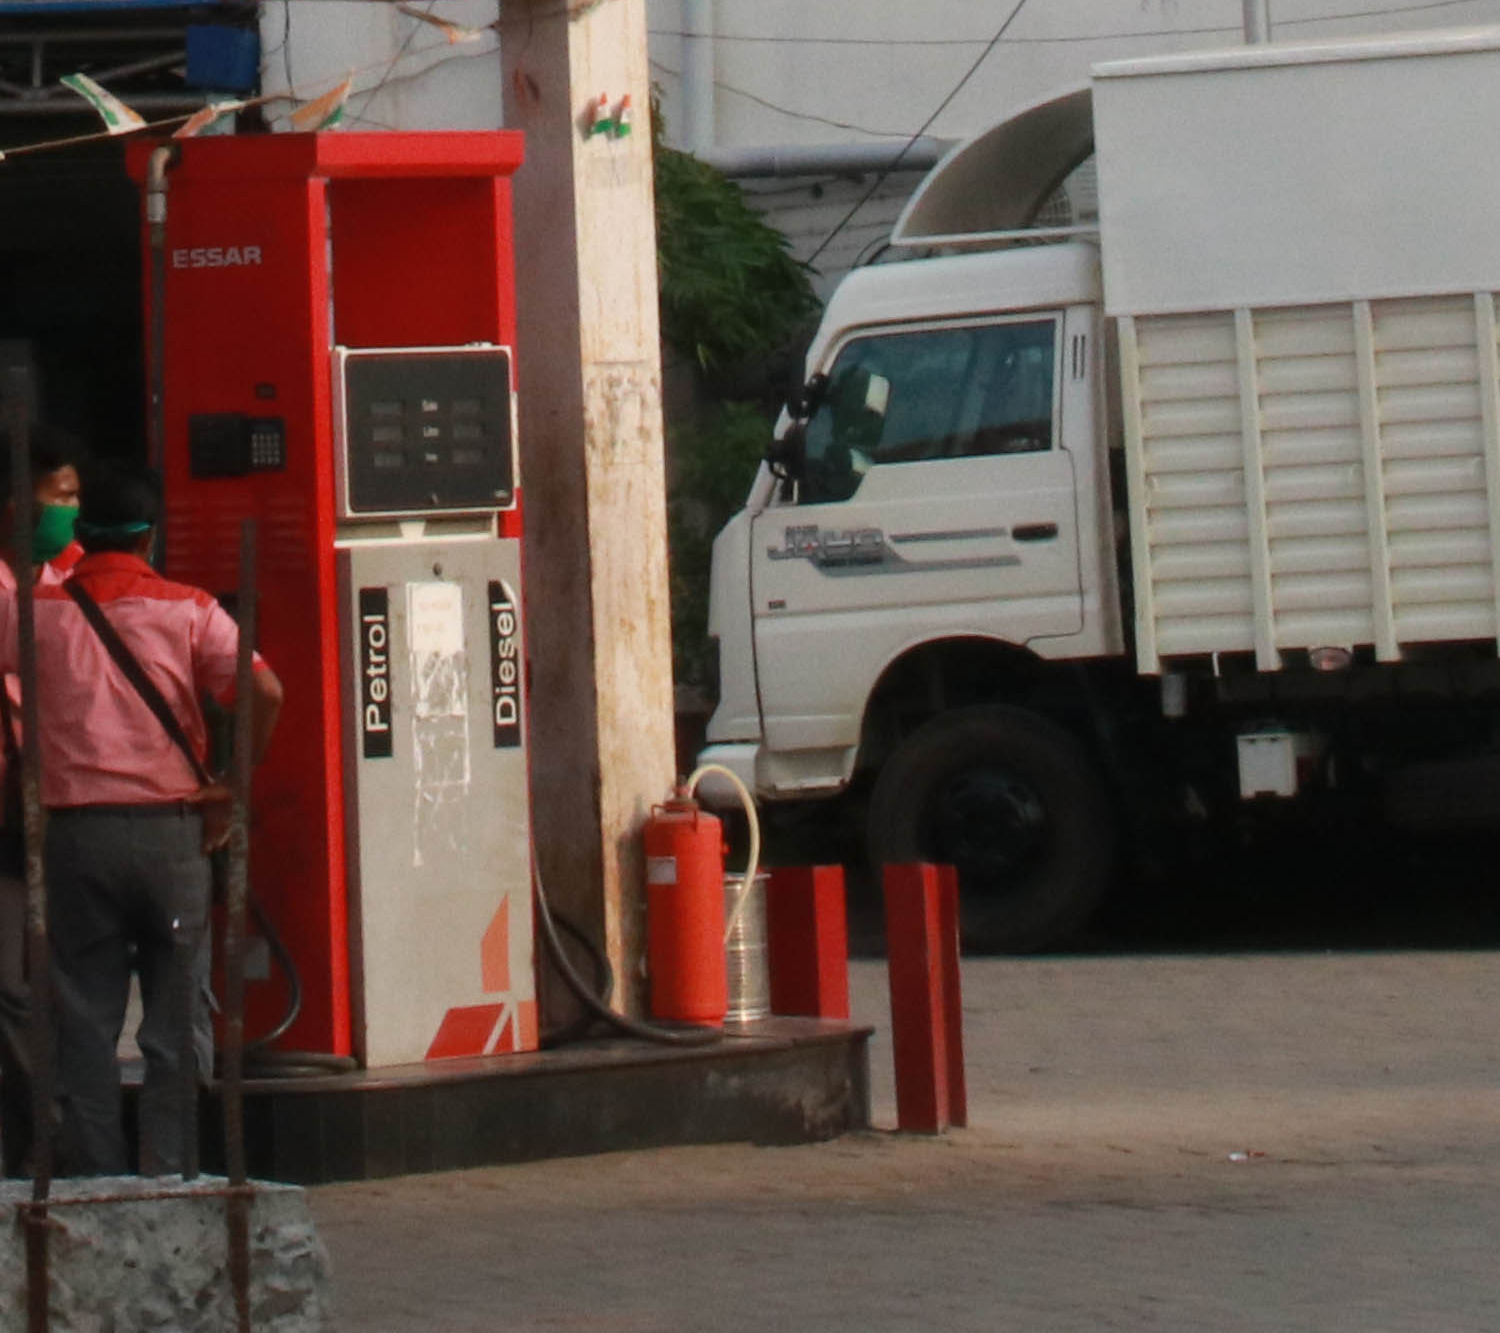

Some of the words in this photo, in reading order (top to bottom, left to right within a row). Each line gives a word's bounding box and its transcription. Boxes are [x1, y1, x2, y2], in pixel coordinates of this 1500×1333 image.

[172, 245, 262, 269] ESSAR
[364, 614, 389, 732] Petrol
[491, 601, 518, 726] Diesel
